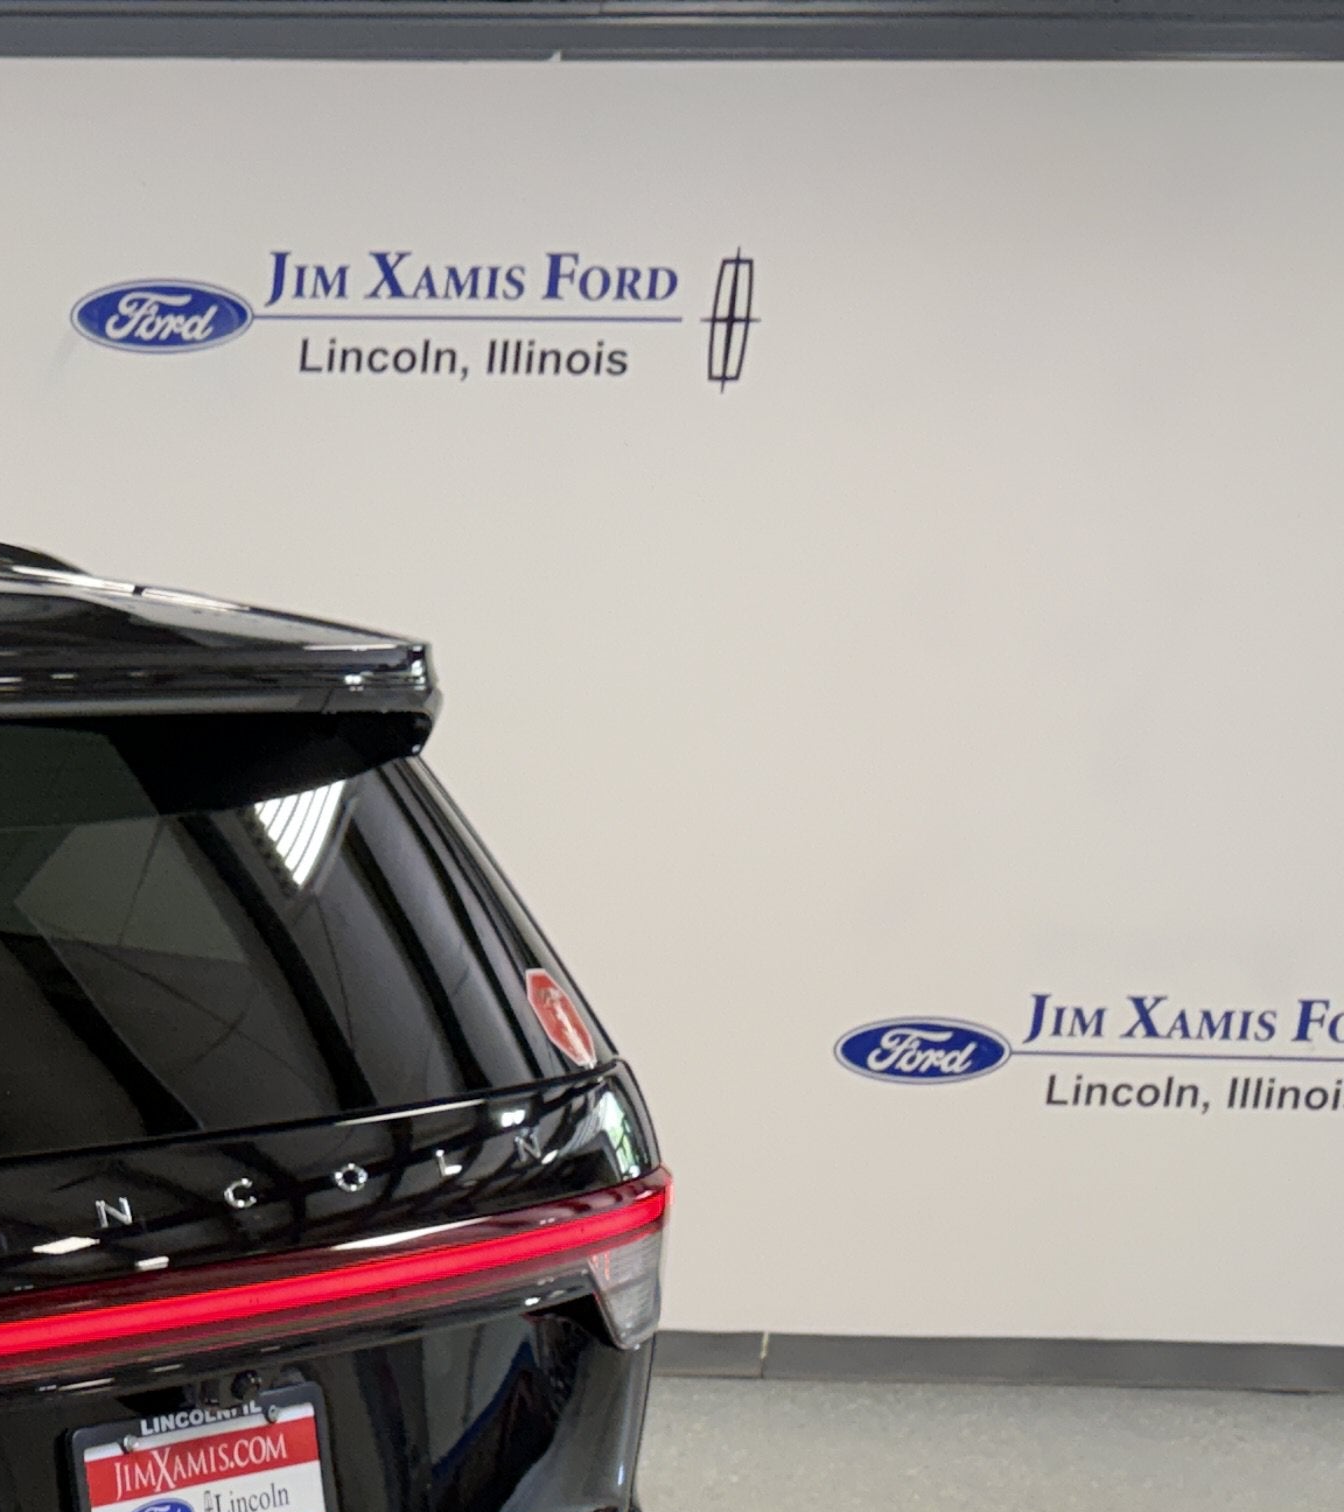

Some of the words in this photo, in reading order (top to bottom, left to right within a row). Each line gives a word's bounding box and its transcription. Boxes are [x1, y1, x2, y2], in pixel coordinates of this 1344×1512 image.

[264, 250, 350, 308] JIM
[367, 250, 526, 301] XAMIS
[543, 252, 679, 302] FORD
[105, 290, 218, 342] Ford
[298, 337, 469, 382] Lincoln,
[486, 338, 629, 377] Illinois
[1022, 993, 1107, 1045] JIM
[1119, 995, 1278, 1043] XAMIS
[867, 1028, 976, 1073] Ford
[1045, 1073, 1210, 1115] Lincoln,
[1226, 1076, 1344, 1112] Illinoi
